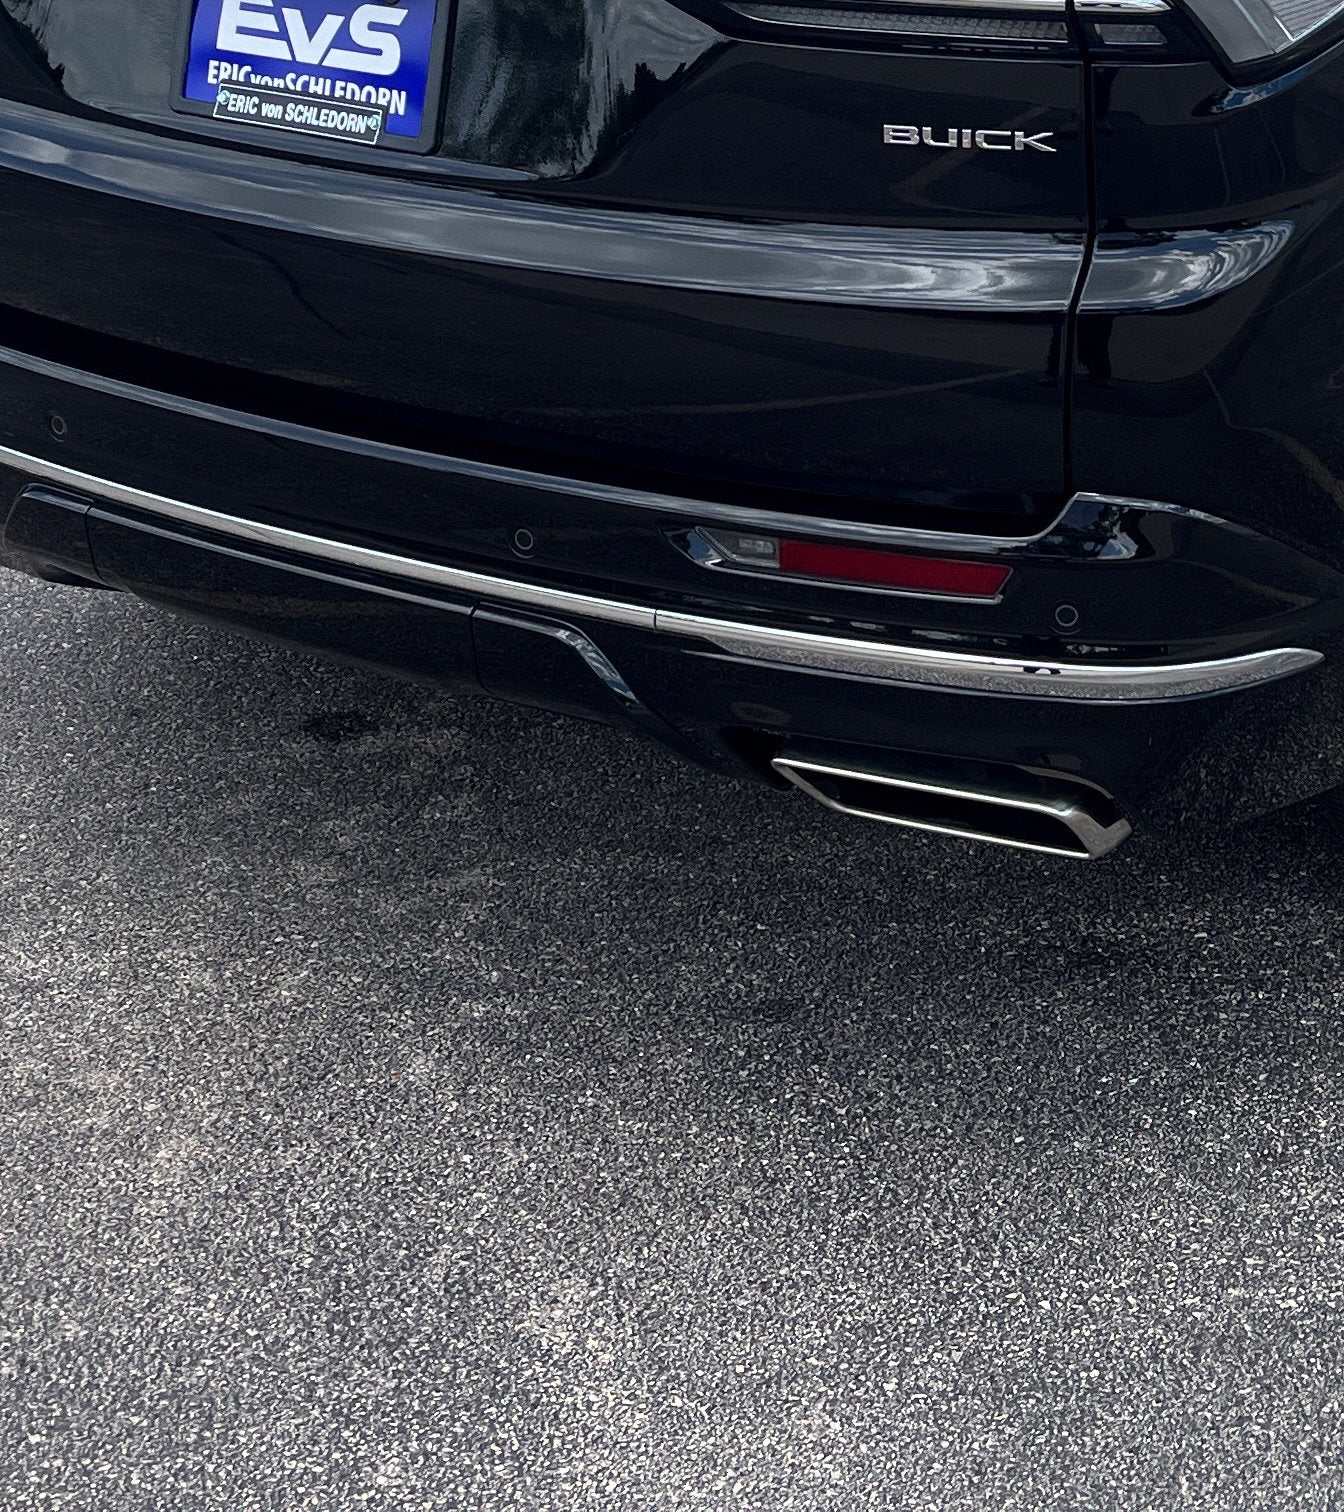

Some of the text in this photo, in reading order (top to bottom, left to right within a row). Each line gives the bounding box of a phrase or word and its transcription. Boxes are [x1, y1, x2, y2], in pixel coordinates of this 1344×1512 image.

[227, 93, 368, 134] ERIC von SCHLEDORN
[883, 124, 1057, 152] BUICK
